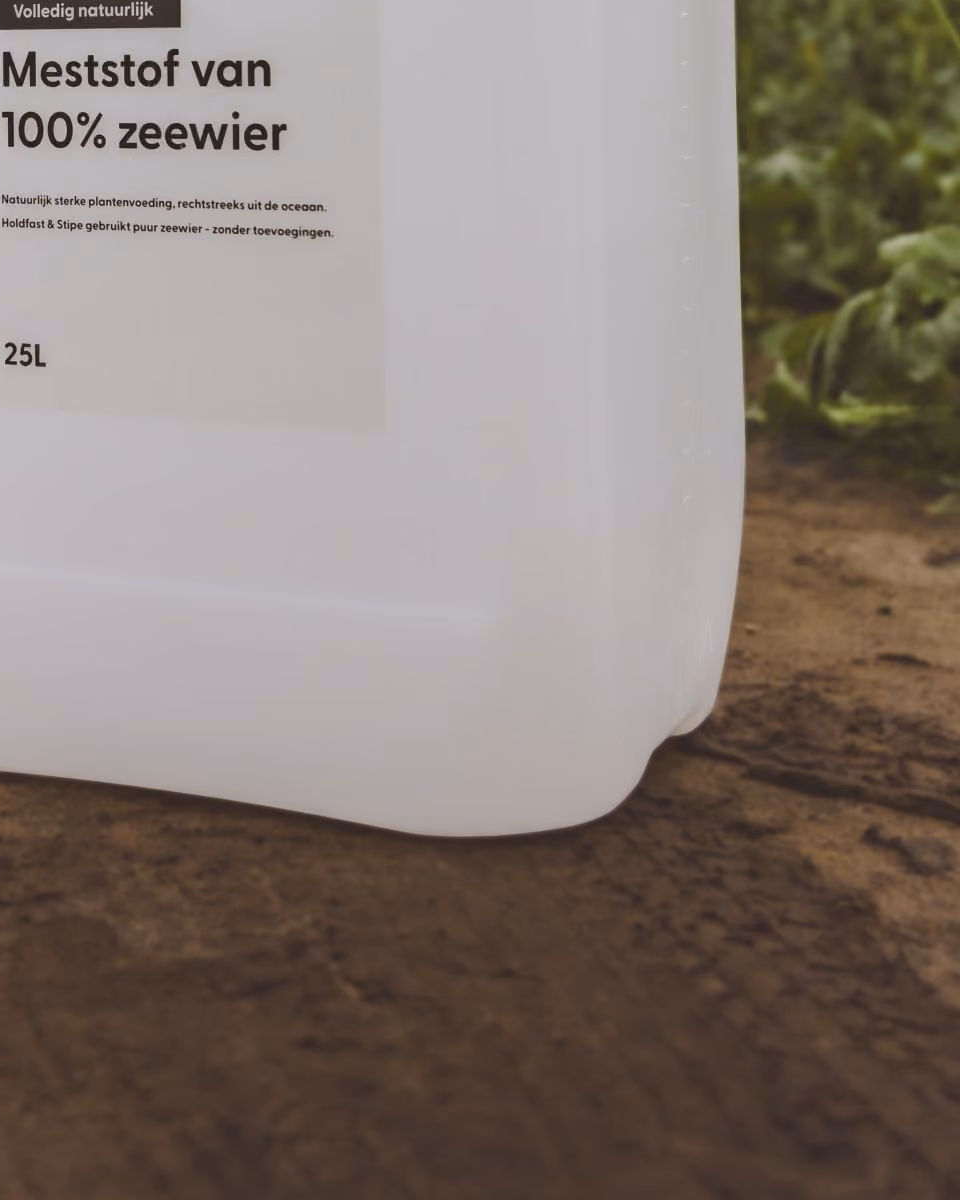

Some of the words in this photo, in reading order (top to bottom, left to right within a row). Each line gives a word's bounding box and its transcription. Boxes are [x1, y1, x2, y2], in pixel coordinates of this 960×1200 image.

[13, 2, 75, 22] Volledig
[78, 1, 154, 20] natuurlijk
[2, 48, 180, 88] Meststof
[190, 59, 272, 88] van
[1, 111, 107, 149] 100%
[118, 110, 288, 152] zeewier
[1, 194, 52, 208] Natuurlijk
[54, 195, 87, 206] sterke
[177, 198, 246, 210] rechtstreeks
[247, 199, 263, 211] uit
[263, 200, 279, 211] de
[280, 203, 327, 212] oceaan.
[1, 217, 46, 229] Holdfast
[46, 219, 55, 230] &
[56, 219, 84, 232] Stipe
[85, 220, 131, 233] gebruikt
[132, 224, 159, 235] puur
[160, 222, 203, 234] zeewier
[212, 224, 251, 235] zonder
[252, 226, 335, 240] toevoegingen.
[4, 341, 47, 368] 25L
